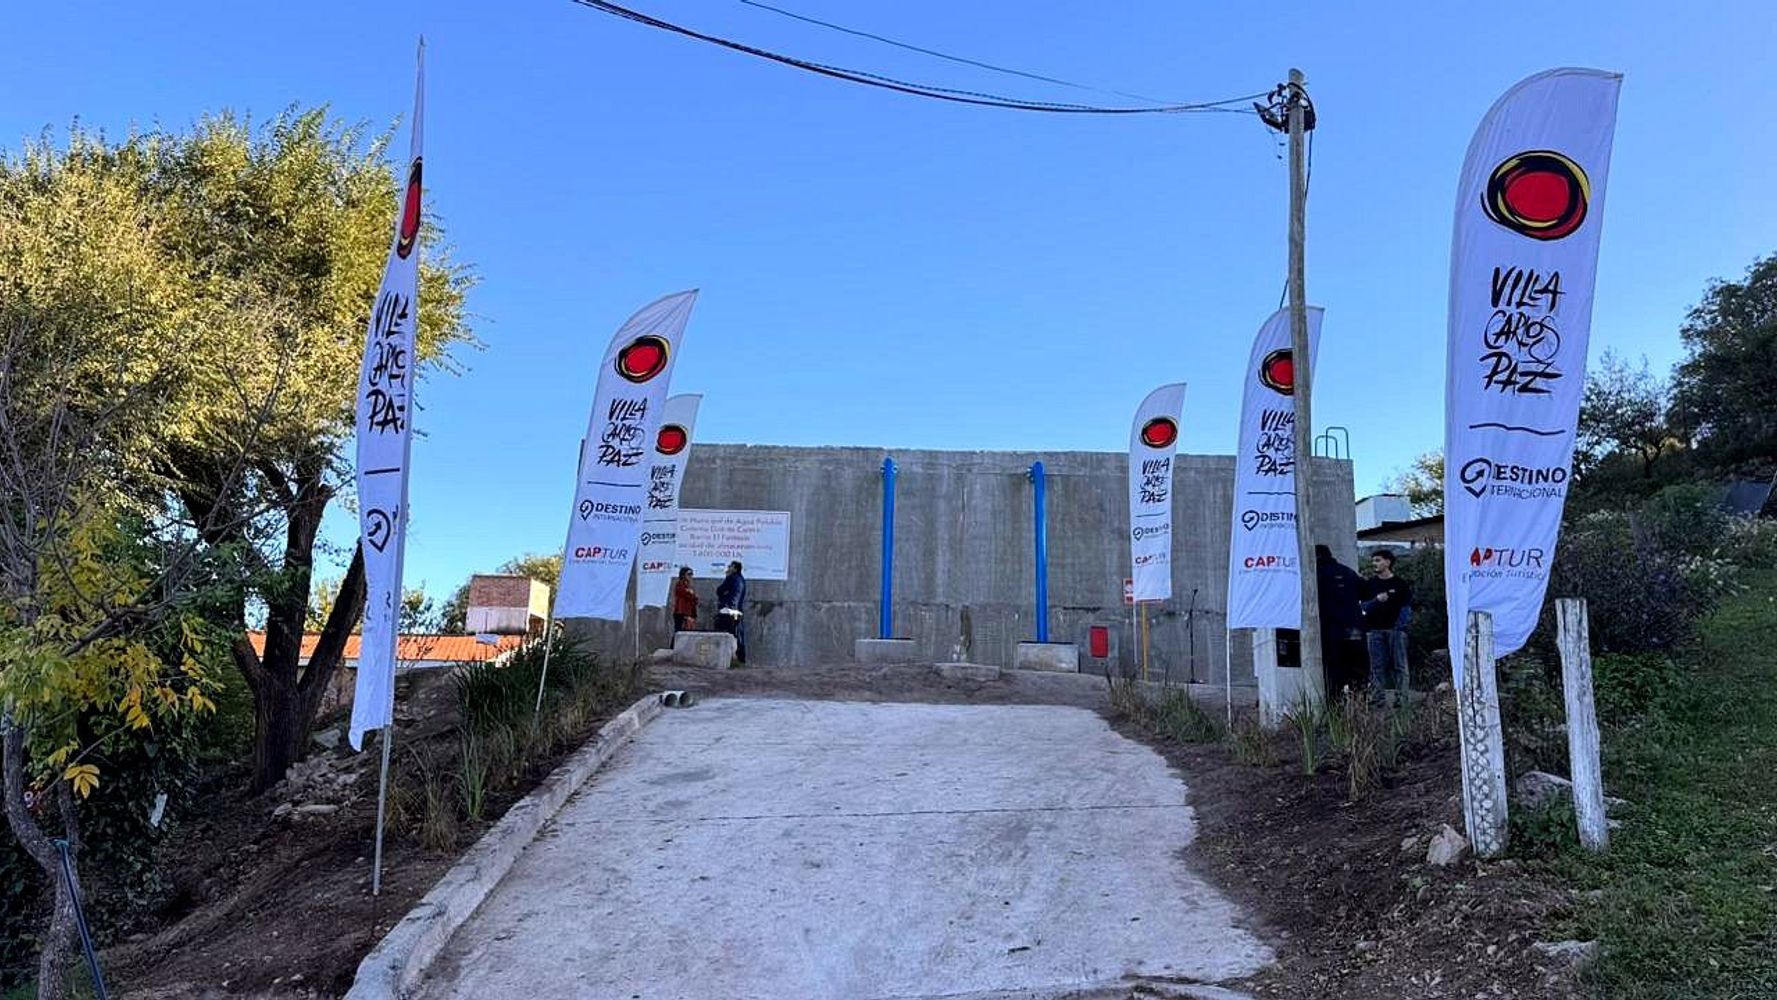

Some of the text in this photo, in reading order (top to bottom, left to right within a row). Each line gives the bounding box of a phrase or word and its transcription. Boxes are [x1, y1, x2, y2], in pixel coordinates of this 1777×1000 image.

[1491, 266, 1566, 313] VILLA
[1484, 309, 1560, 364] CARLOS
[1479, 351, 1563, 395] PAZ
[609, 397, 648, 421] VILLA
[598, 444, 644, 468] PAZ
[1142, 457, 1170, 475] VILLA
[1255, 454, 1295, 477] PAZ
[1492, 464, 1567, 485] ESTINO
[1139, 490, 1167, 503] PAZ
[595, 503, 641, 514] DESTINO
[575, 547, 628, 560] CAPTUR
